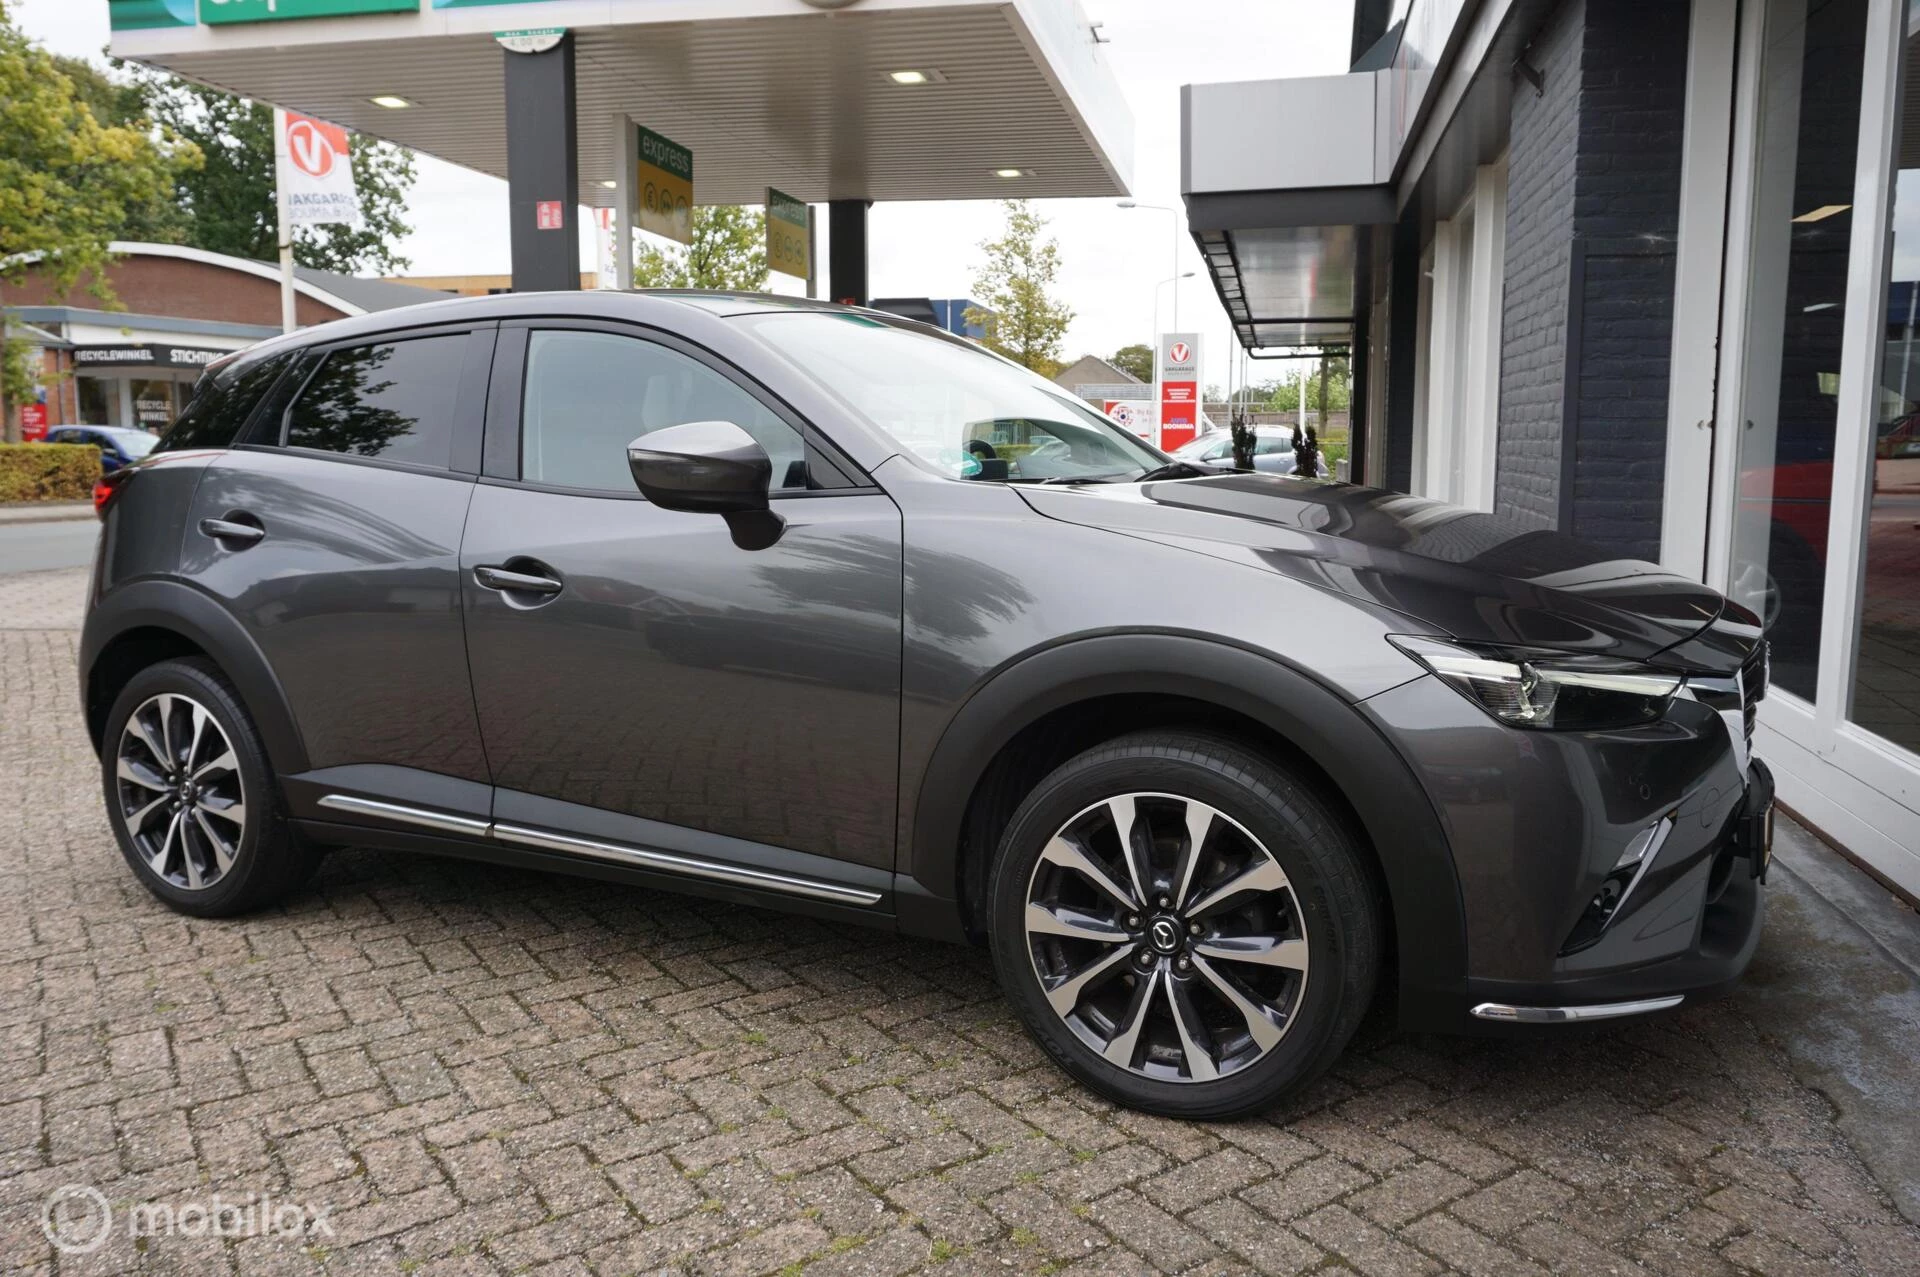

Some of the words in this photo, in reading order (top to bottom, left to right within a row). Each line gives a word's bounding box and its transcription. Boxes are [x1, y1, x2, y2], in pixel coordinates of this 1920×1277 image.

[642, 135, 690, 173] express
[75, 349, 154, 361] RECYCLEWINKEL
[137, 400, 172, 410] RECYCLE
[139, 411, 170, 422] WINKEL
